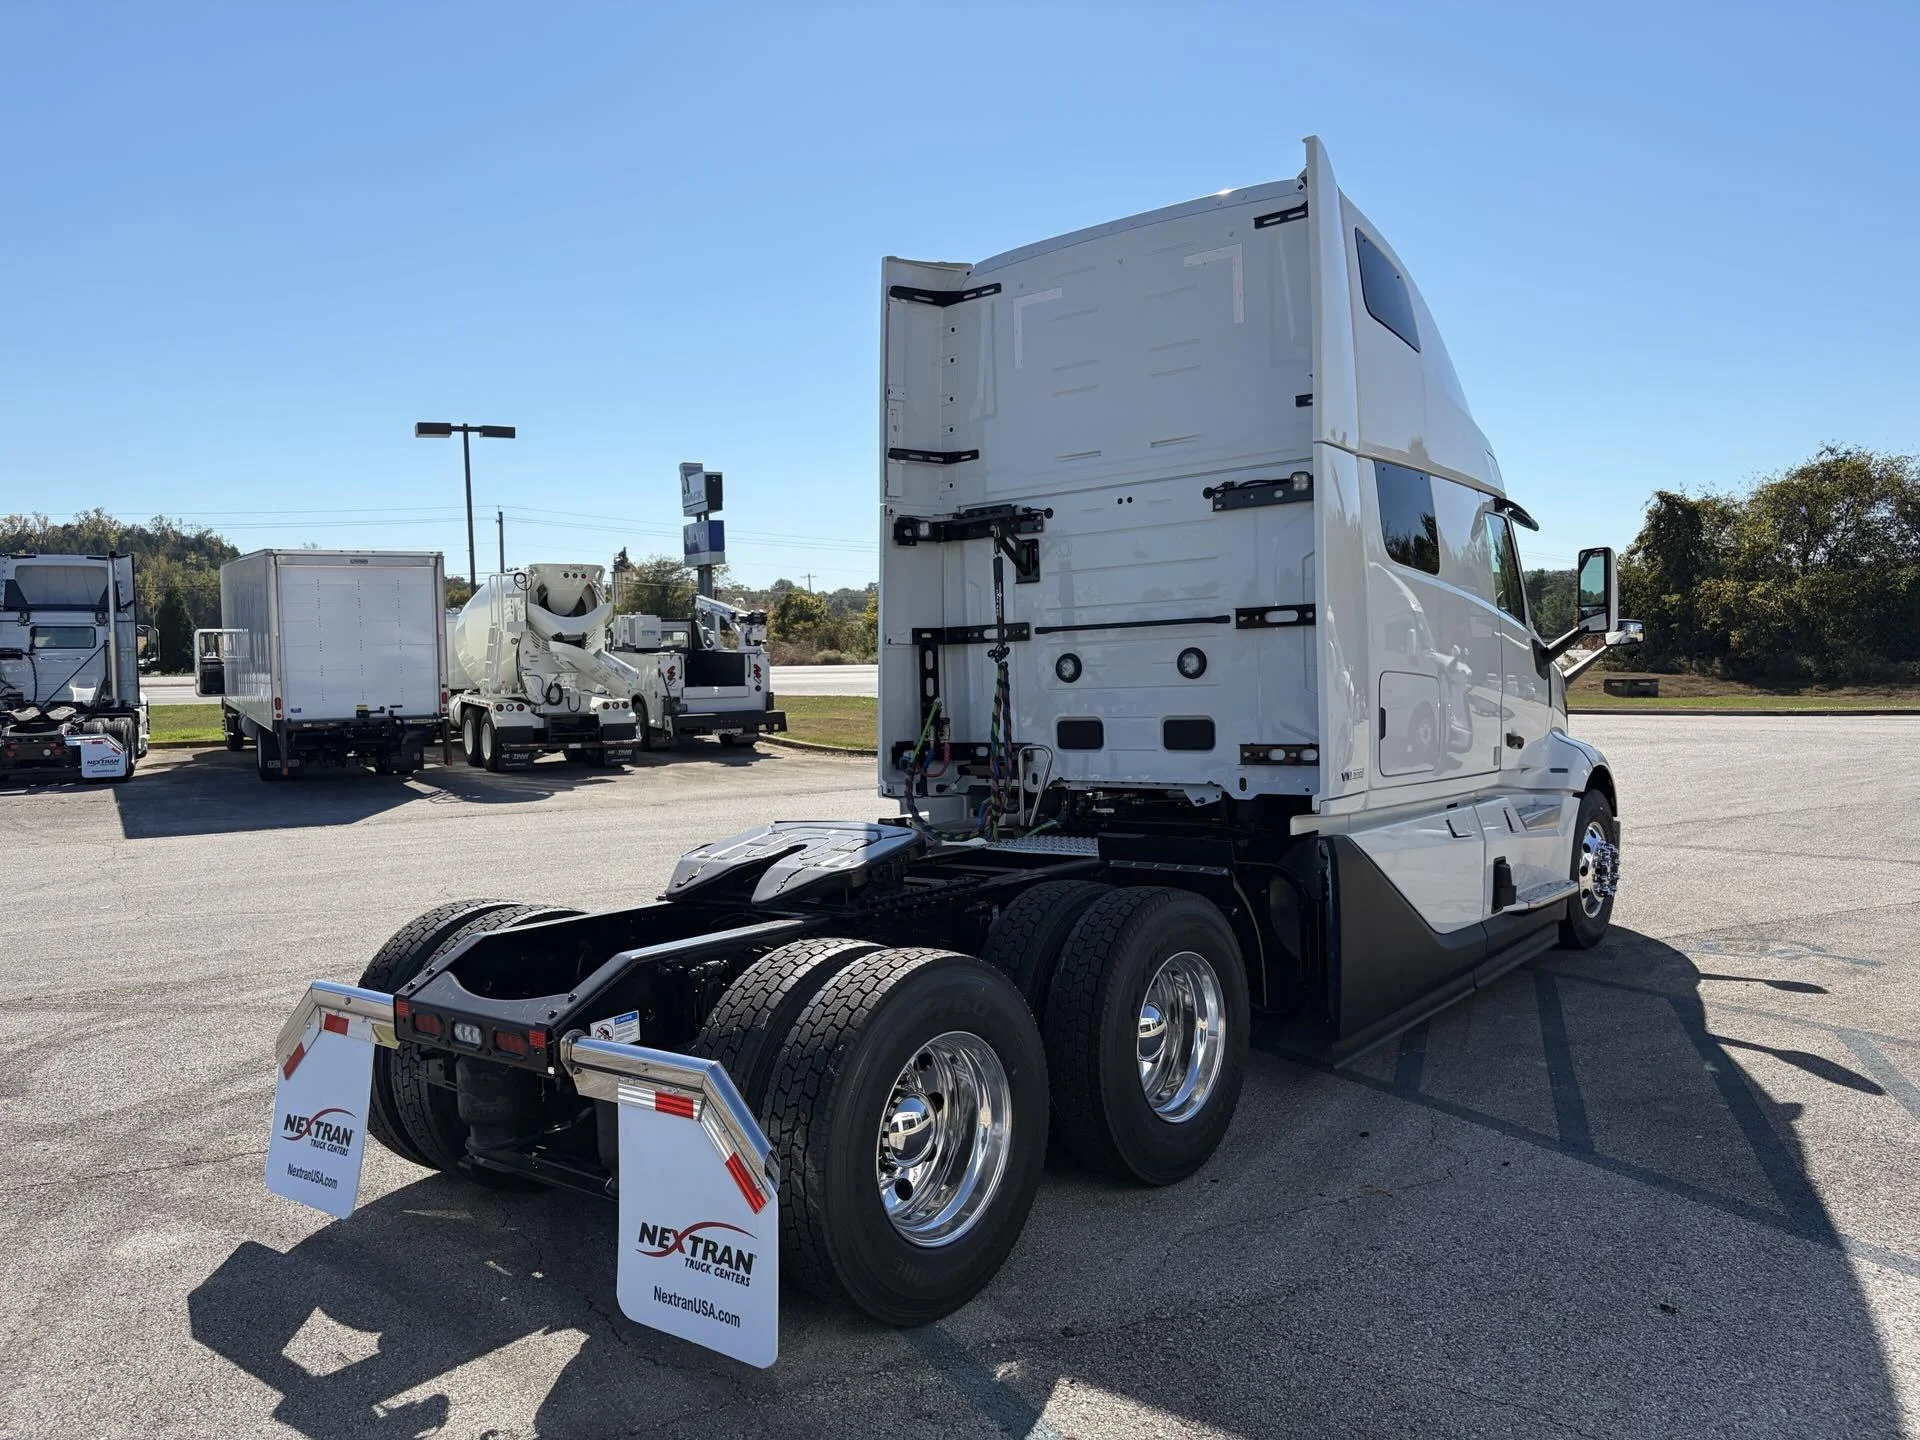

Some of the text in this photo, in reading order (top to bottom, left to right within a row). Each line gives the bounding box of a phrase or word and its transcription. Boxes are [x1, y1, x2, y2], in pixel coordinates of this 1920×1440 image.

[282, 1111, 354, 1147] NEXTRAN
[310, 1138, 349, 1156] TRUCK CENTERS
[287, 1162, 338, 1189] NextranUSA.com
[637, 1221, 756, 1275] NEXTRAN
[684, 1257, 751, 1287] TRUCK CENTERS
[653, 1285, 740, 1328] NextranUSA.com
